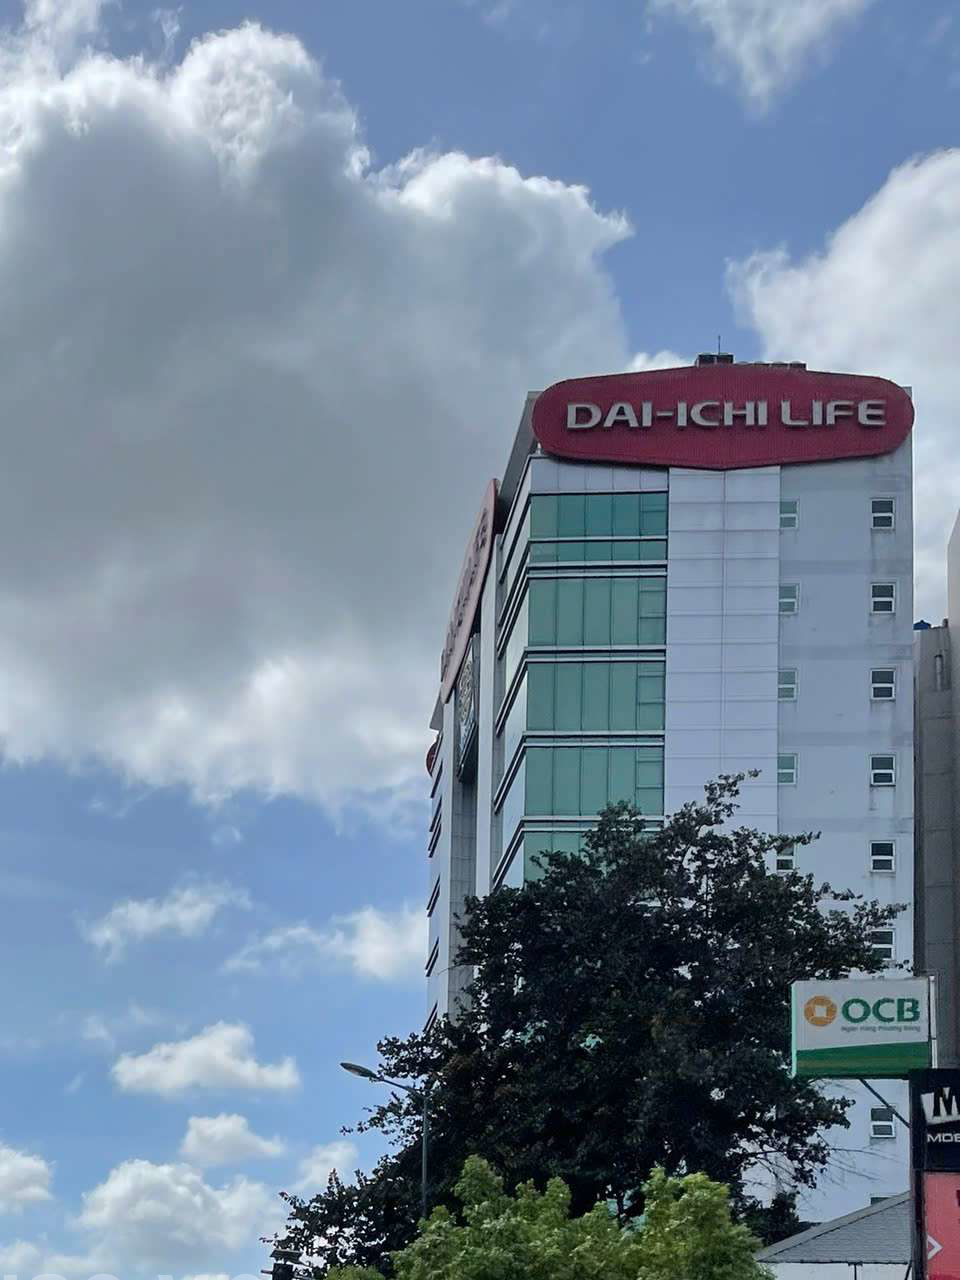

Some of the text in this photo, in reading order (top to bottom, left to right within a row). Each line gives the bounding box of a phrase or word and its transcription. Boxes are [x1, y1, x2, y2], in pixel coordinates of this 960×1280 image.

[566, 399, 888, 430] DAI-ICHI LIFE
[841, 997, 921, 1023] OCB
